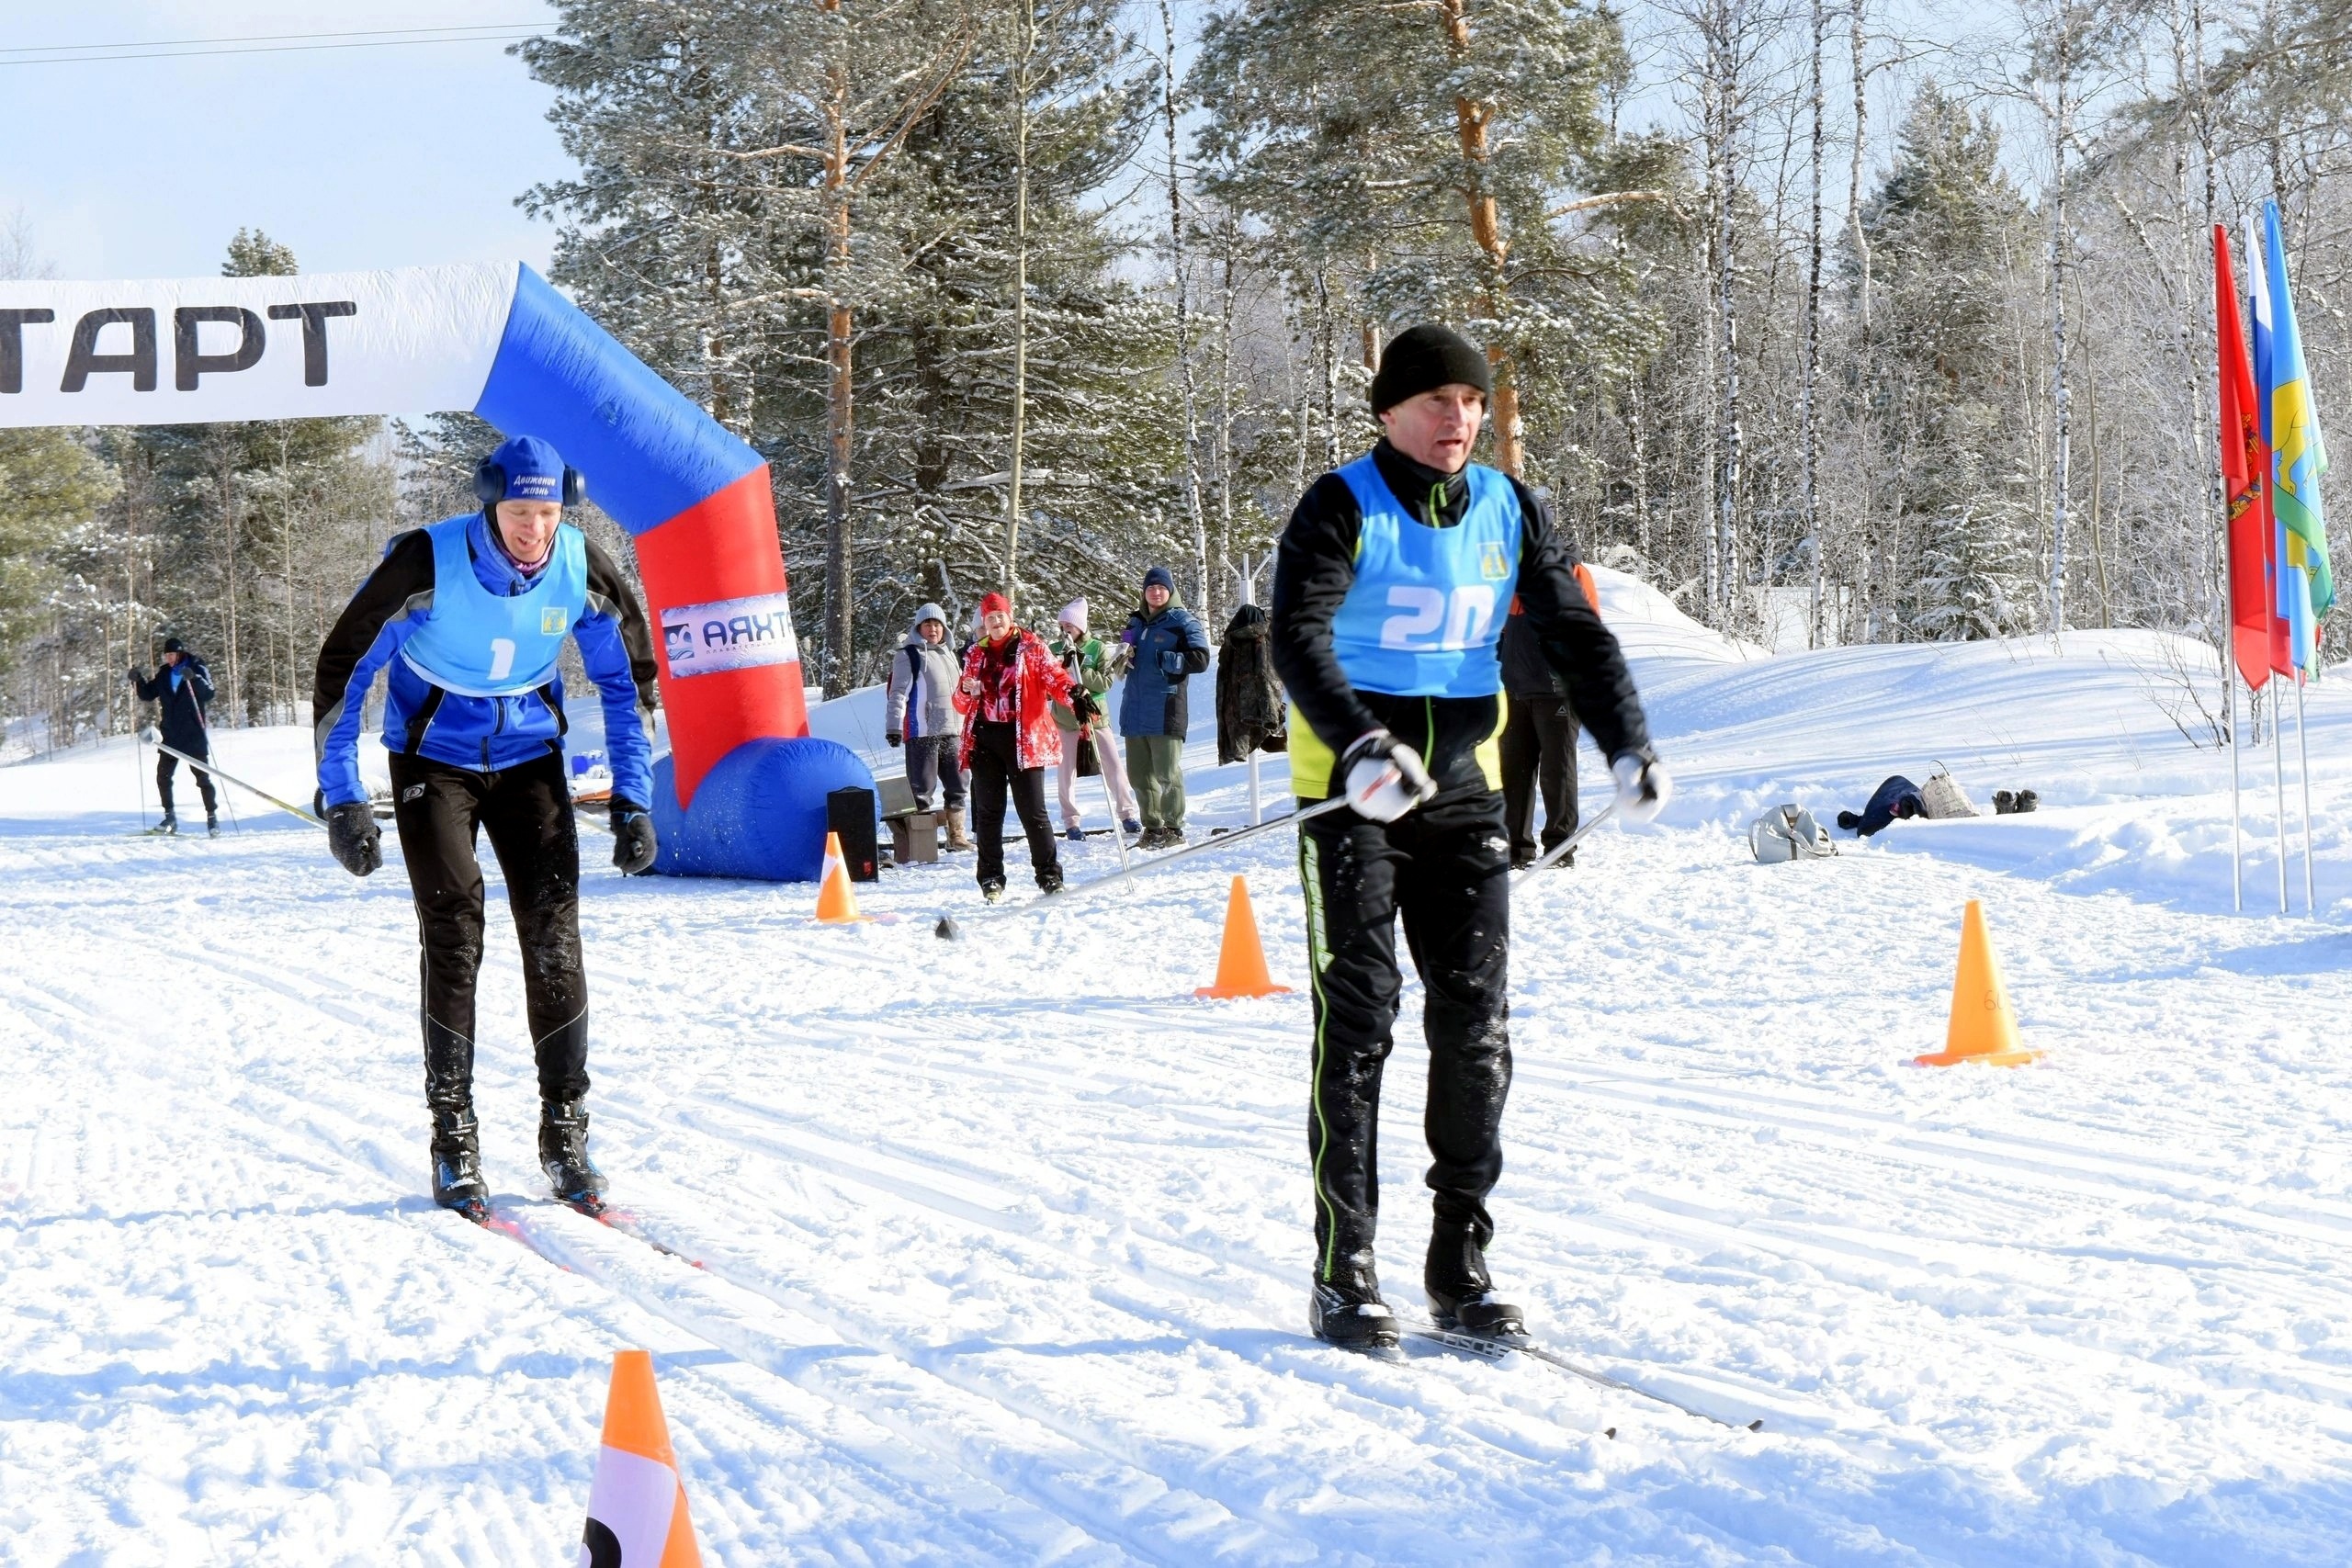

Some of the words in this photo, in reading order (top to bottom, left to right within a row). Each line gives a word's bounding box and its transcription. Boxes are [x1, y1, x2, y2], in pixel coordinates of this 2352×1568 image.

[514, 474, 556, 487] Движение
[702, 611, 793, 648] АЯХТ
[1381, 585, 1495, 651] 20
[487, 637, 516, 681] 1
[1442, 1332, 1510, 1359] FISCHE
